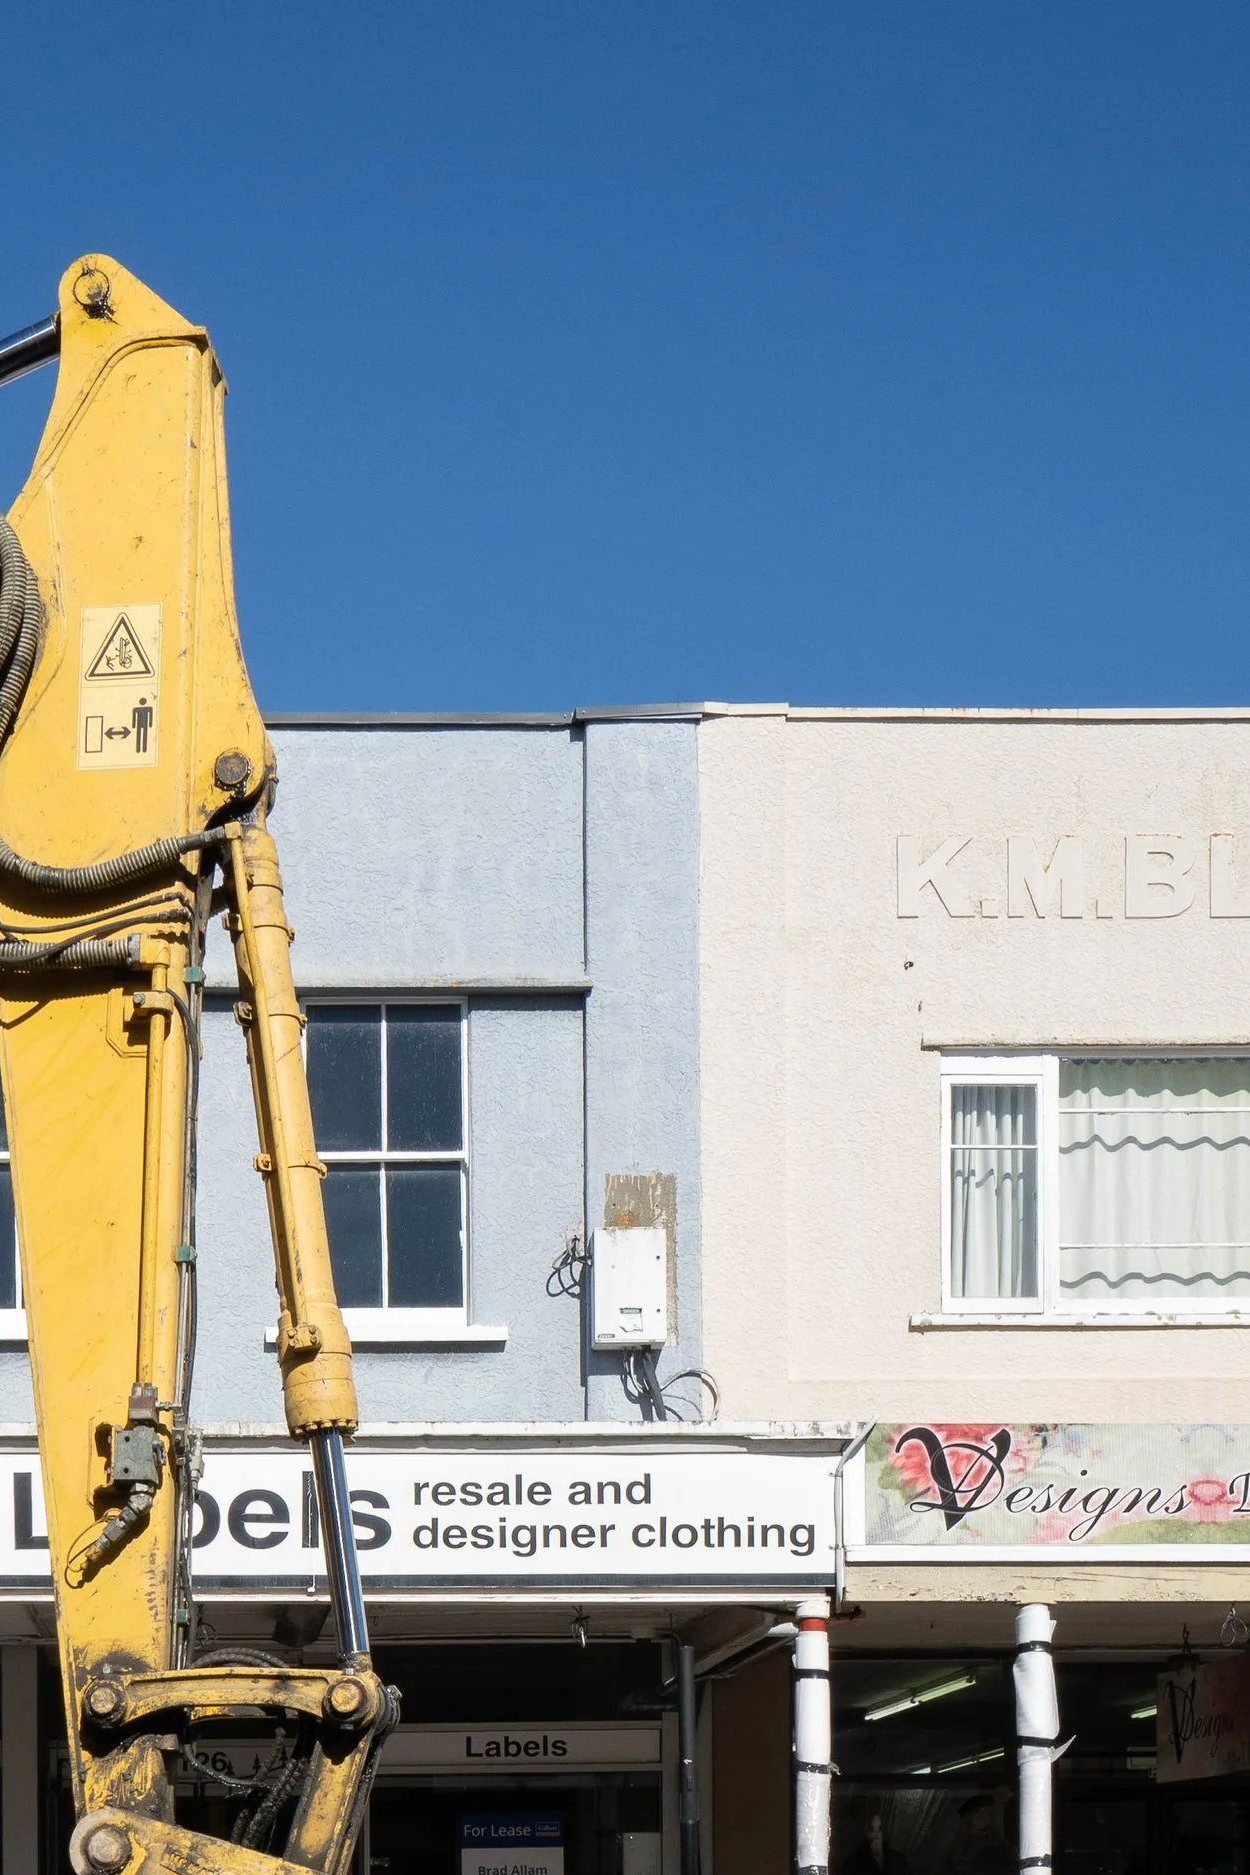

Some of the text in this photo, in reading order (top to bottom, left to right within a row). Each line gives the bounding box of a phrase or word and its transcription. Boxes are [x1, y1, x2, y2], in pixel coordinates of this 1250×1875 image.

[413, 1473, 652, 1506] resale and
[13, 1471, 393, 1551] Lels
[412, 1516, 816, 1558] designer clothing
[466, 1735, 568, 1757] Labels
[463, 1823, 532, 1838] For Lease
[511, 1864, 548, 1875] Allam
